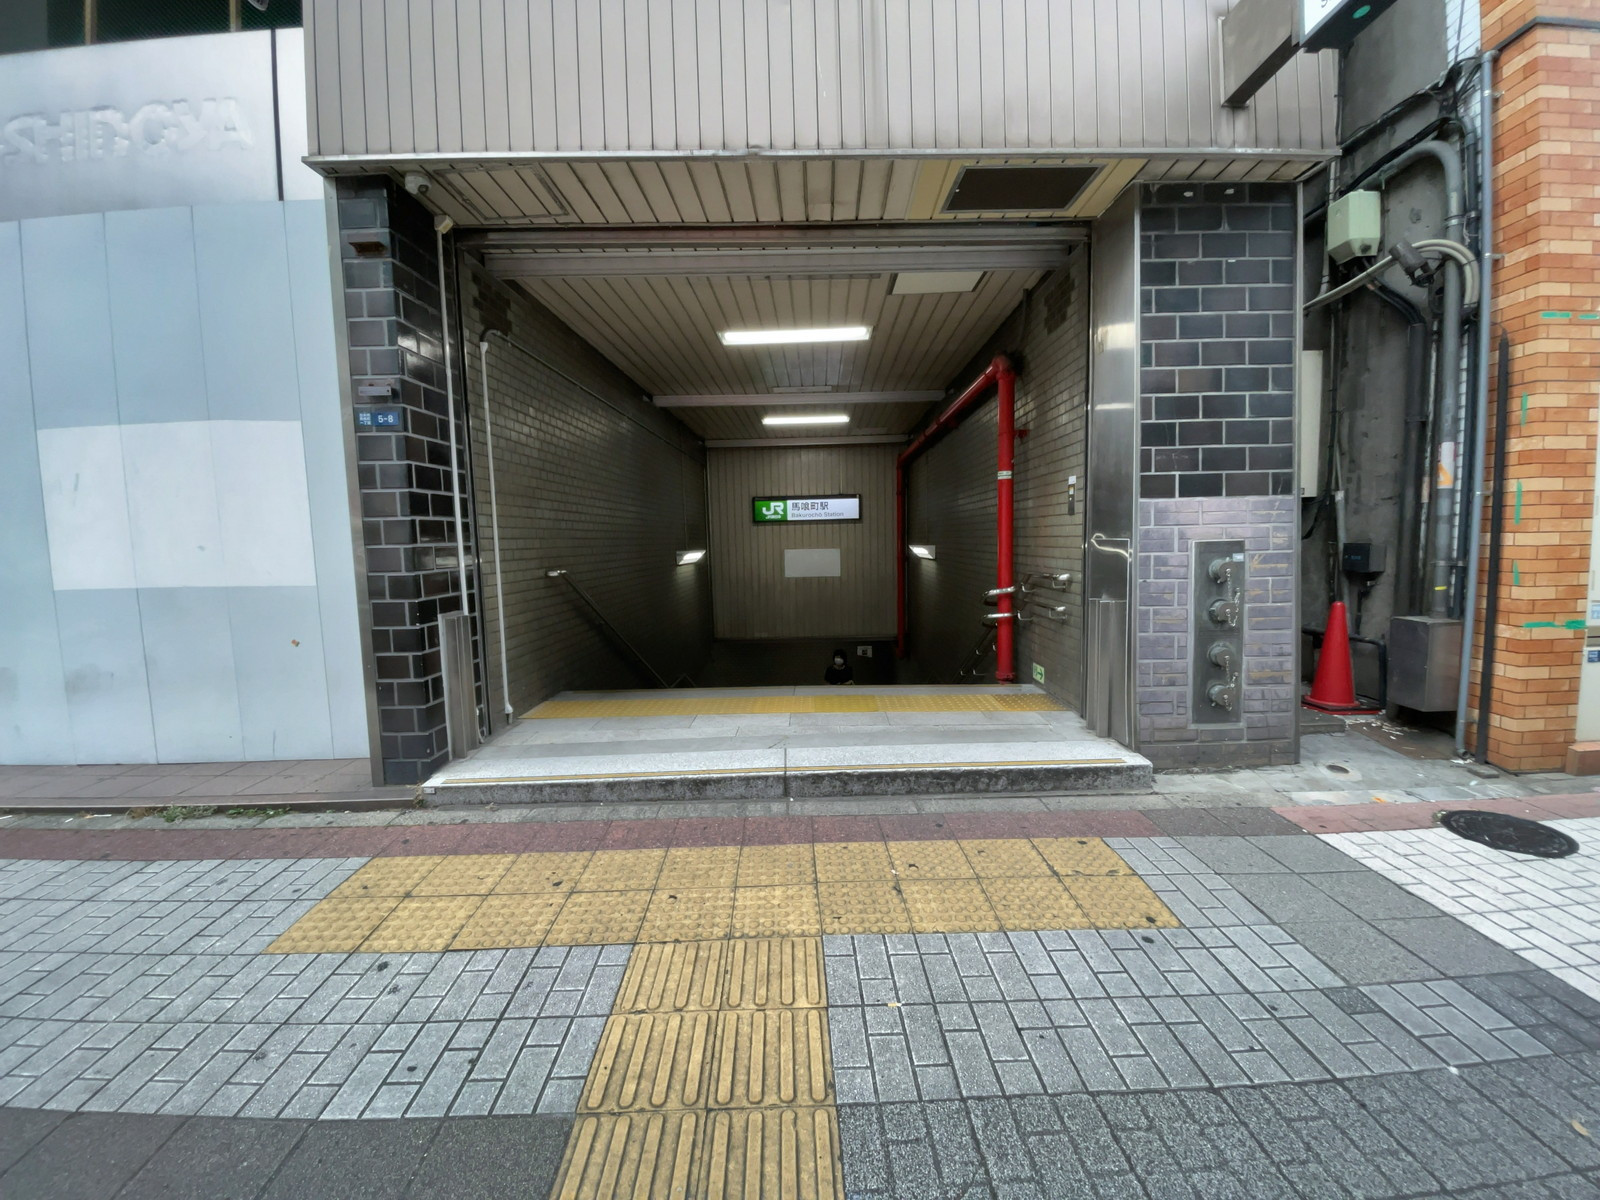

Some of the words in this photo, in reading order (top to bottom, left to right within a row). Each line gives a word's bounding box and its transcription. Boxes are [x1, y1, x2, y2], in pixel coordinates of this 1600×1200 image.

[762, 502, 785, 515] JR
[791, 501, 829, 511] 馬喰町駅
